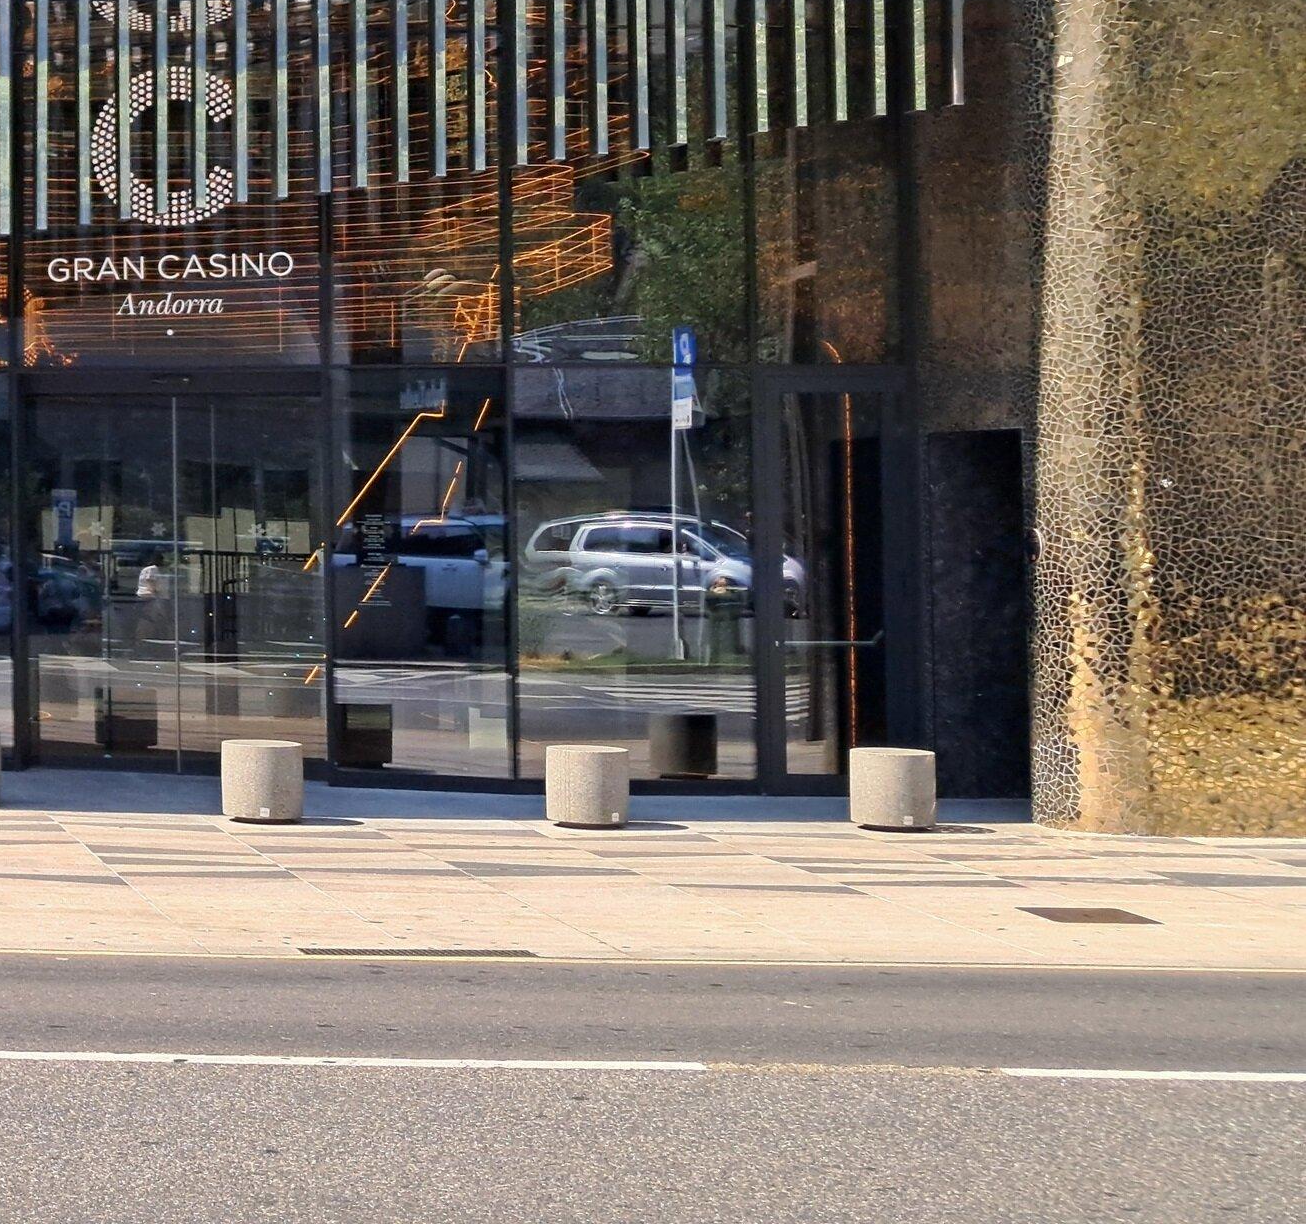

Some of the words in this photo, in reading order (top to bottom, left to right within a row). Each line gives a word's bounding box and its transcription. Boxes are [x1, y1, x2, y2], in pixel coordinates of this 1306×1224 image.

[47, 256, 146, 282] GRAN
[157, 251, 294, 280] CASINO
[116, 292, 224, 316] Andorra
